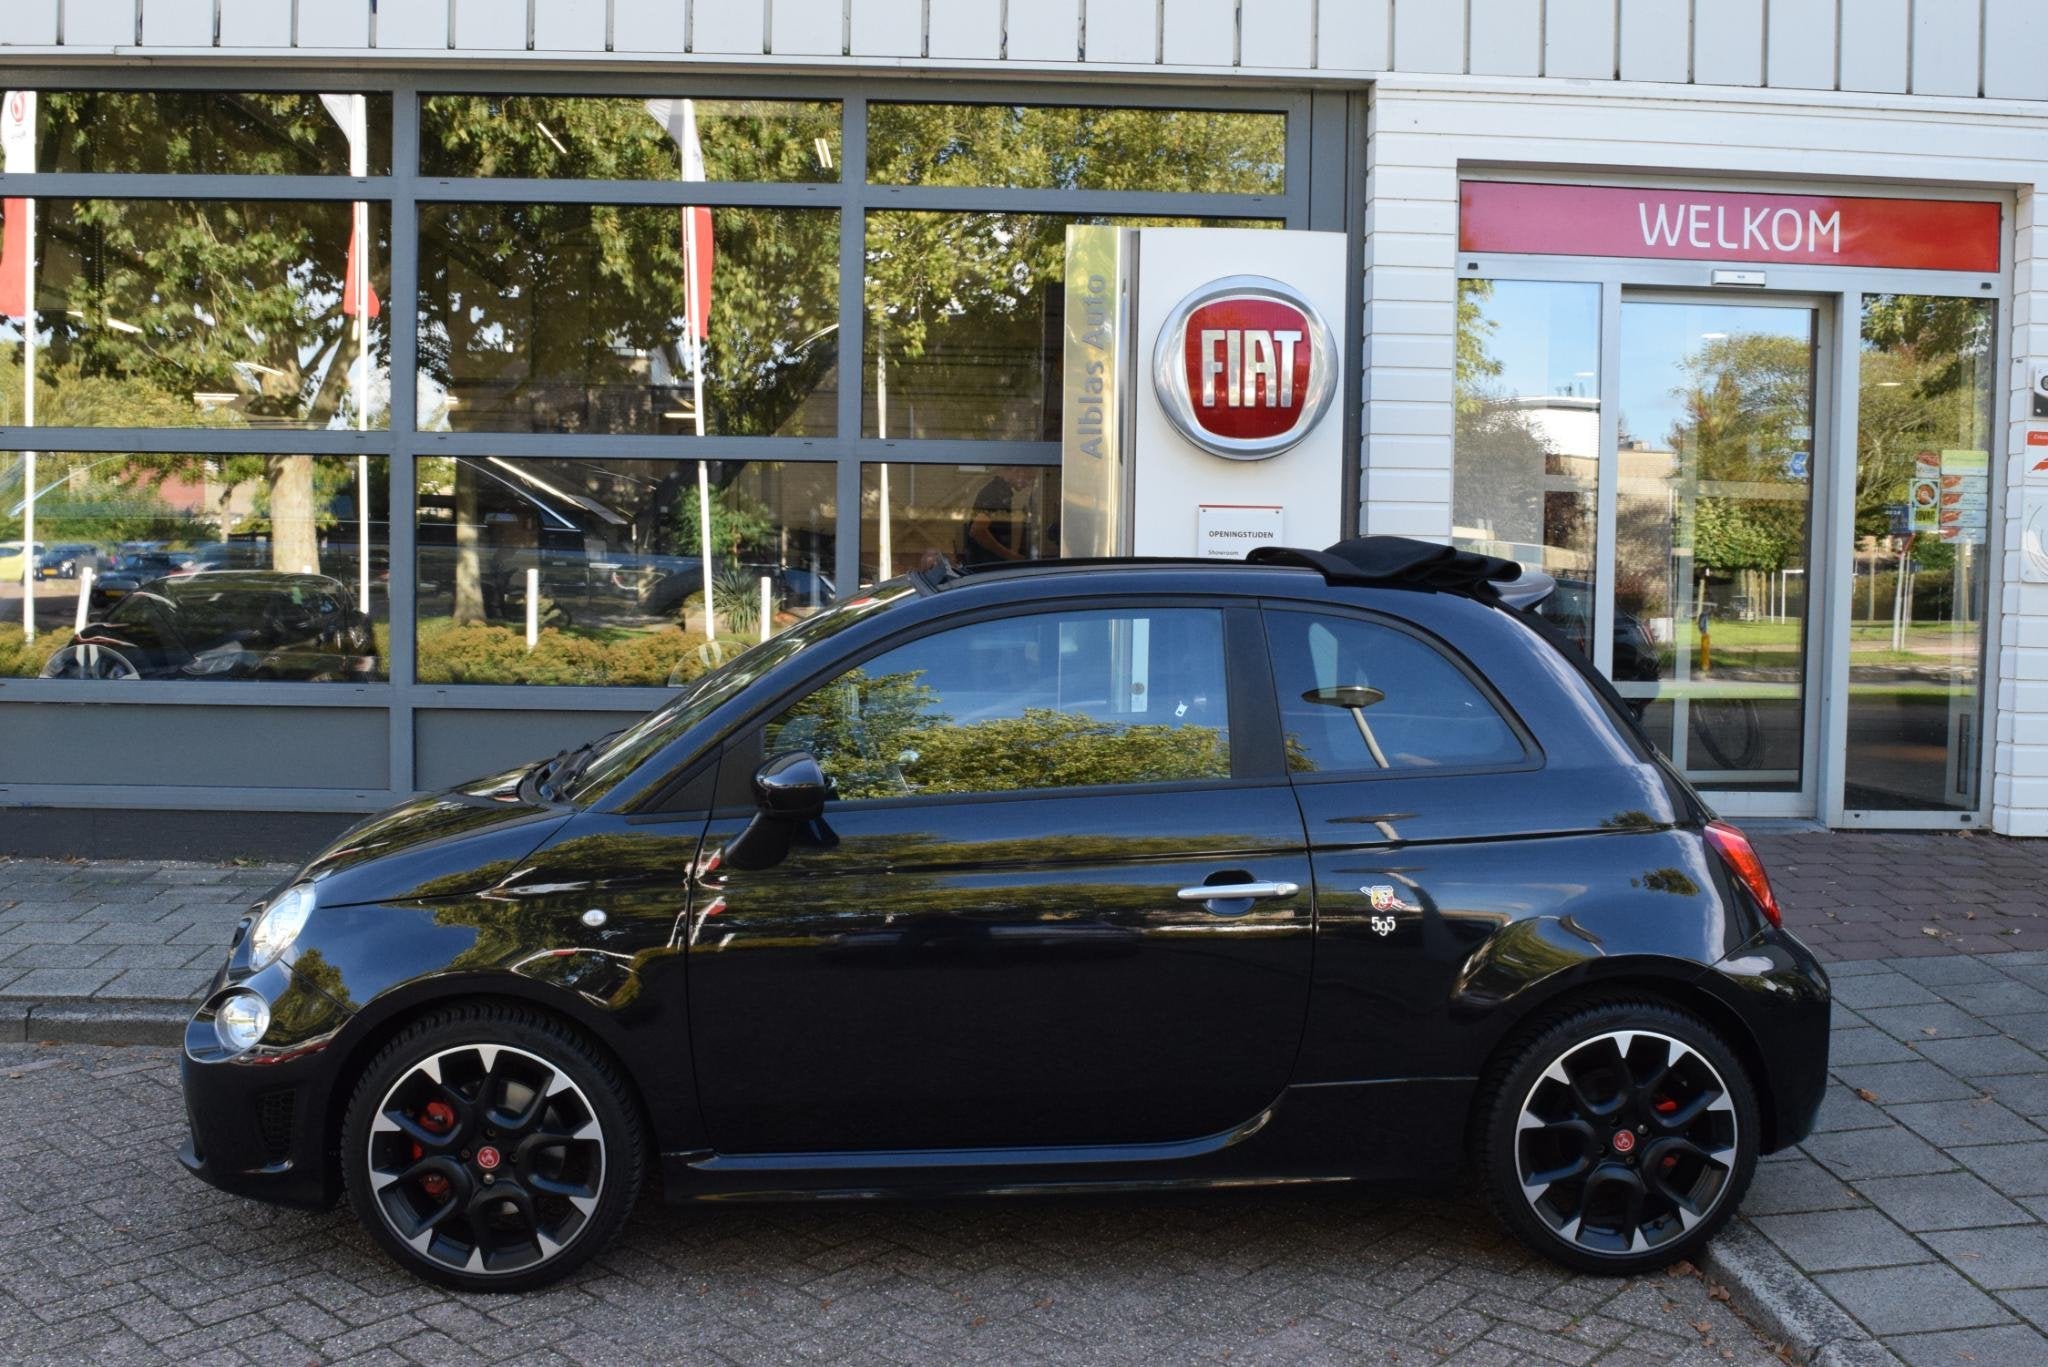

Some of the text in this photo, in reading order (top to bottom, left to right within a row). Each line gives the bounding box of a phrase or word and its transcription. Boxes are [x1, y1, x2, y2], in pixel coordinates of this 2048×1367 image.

[1639, 203, 1841, 253] WELKOM
[1077, 274, 1106, 460] Alblas Auto
[1201, 329, 1302, 408] FIAT
[1208, 530, 1274, 539] OPENINGSTIJDEN
[1371, 916, 1396, 937] 595
